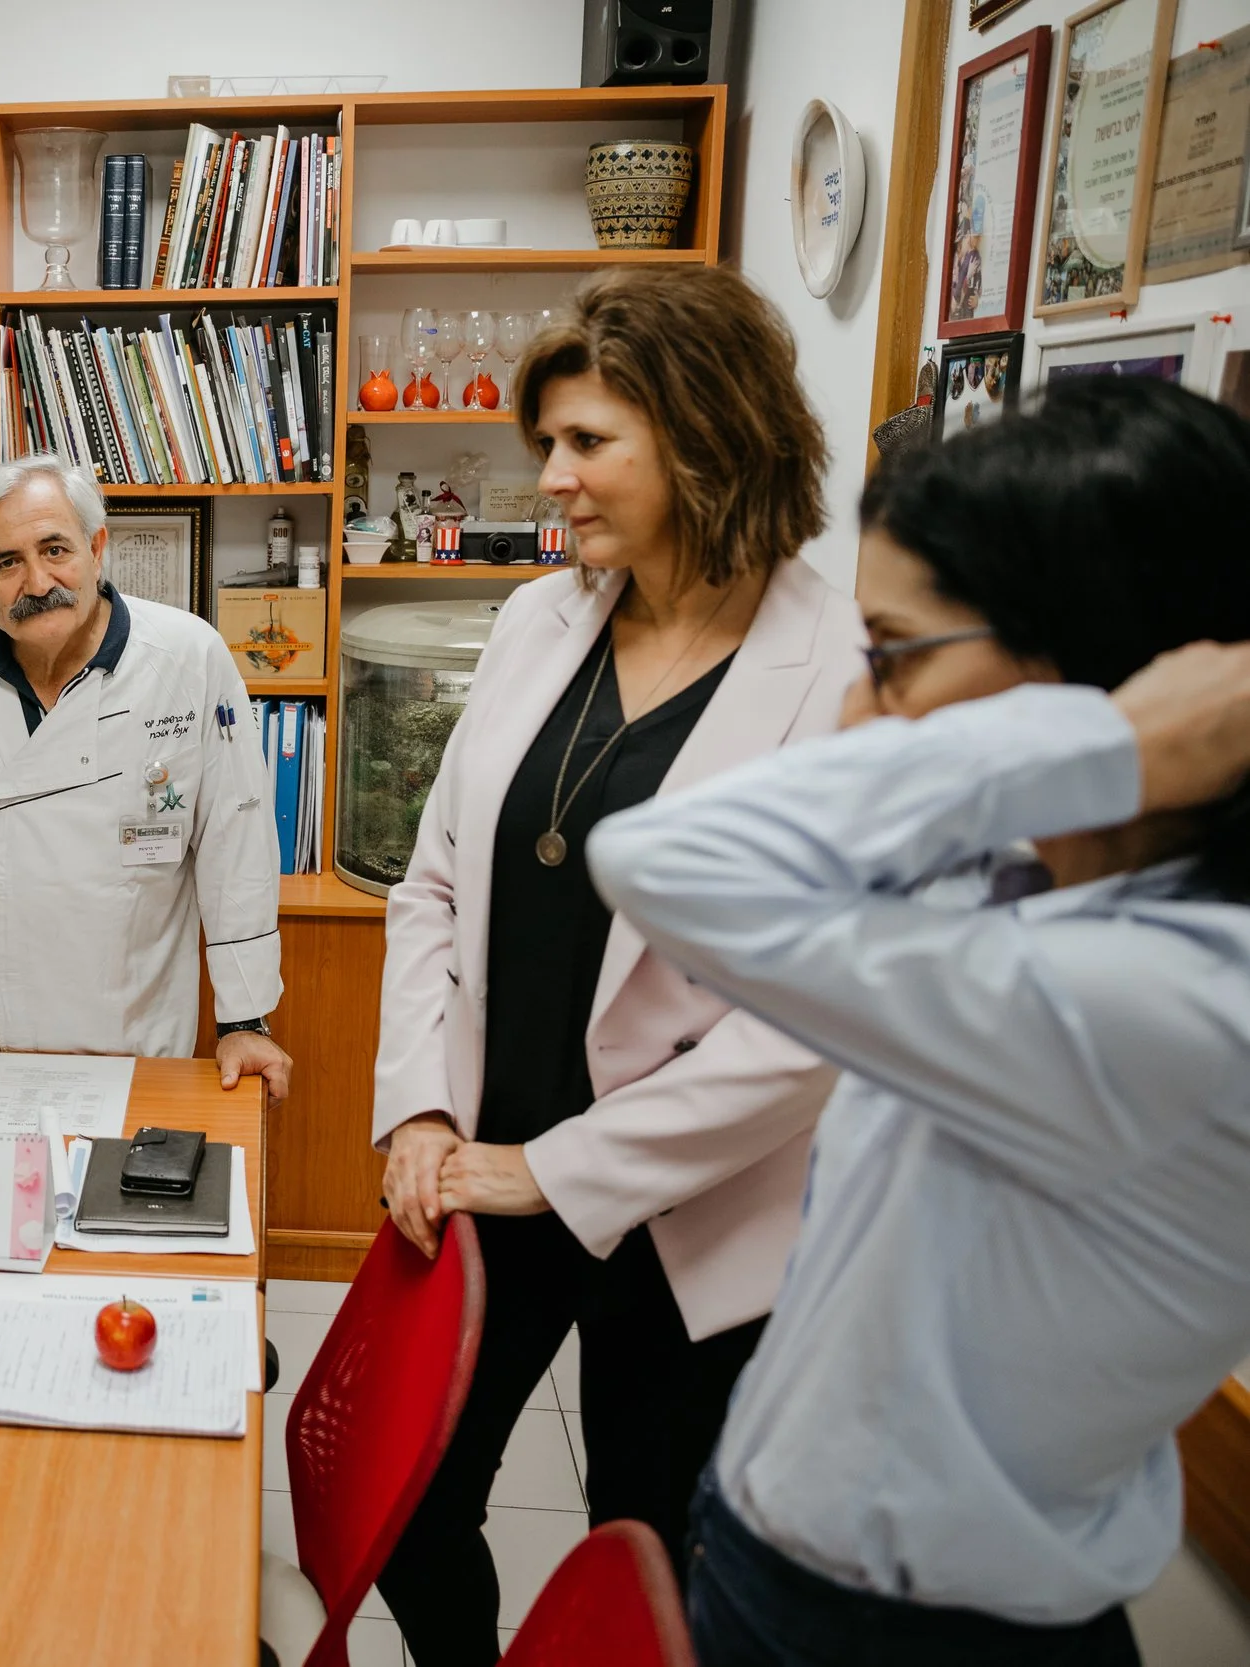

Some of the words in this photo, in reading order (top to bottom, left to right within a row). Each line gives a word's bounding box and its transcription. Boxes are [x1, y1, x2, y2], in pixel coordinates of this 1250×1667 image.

[302, 330, 310, 348] CAT
[273, 528, 288, 537] 600
[134, 534, 159, 545] יהוה
